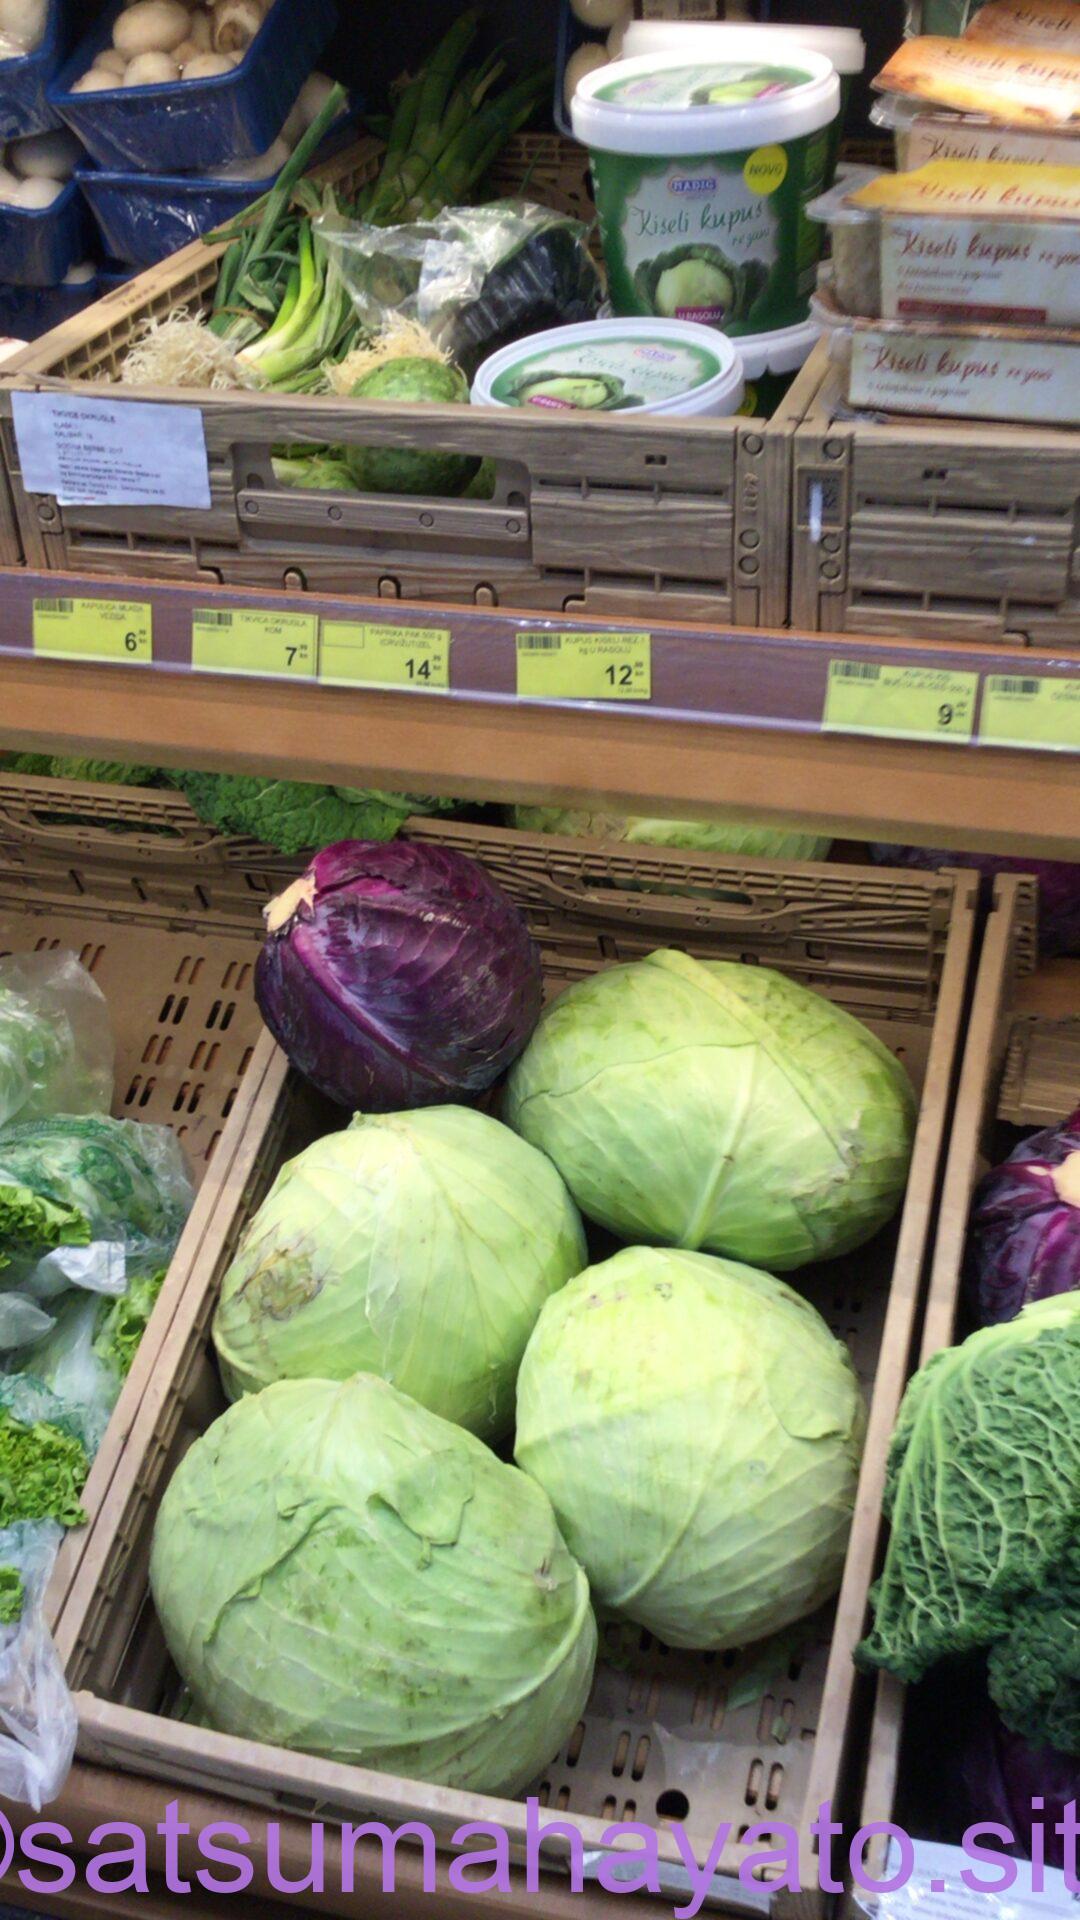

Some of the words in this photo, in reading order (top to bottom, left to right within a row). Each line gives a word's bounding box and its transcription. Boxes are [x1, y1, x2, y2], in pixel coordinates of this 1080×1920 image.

[630, 206, 689, 236] Kiseli
[701, 202, 762, 236] kupus
[893, 227, 958, 257] Kiseli
[966, 232, 1032, 266] kupus
[864, 345, 928, 373] Kiseli
[936, 349, 999, 383] kupus
[125, 632, 137, 652] 6
[285, 646, 297, 666] 7
[405, 658, 431, 679] 14
[605, 664, 633, 685] 12
[938, 703, 954, 725] 9
